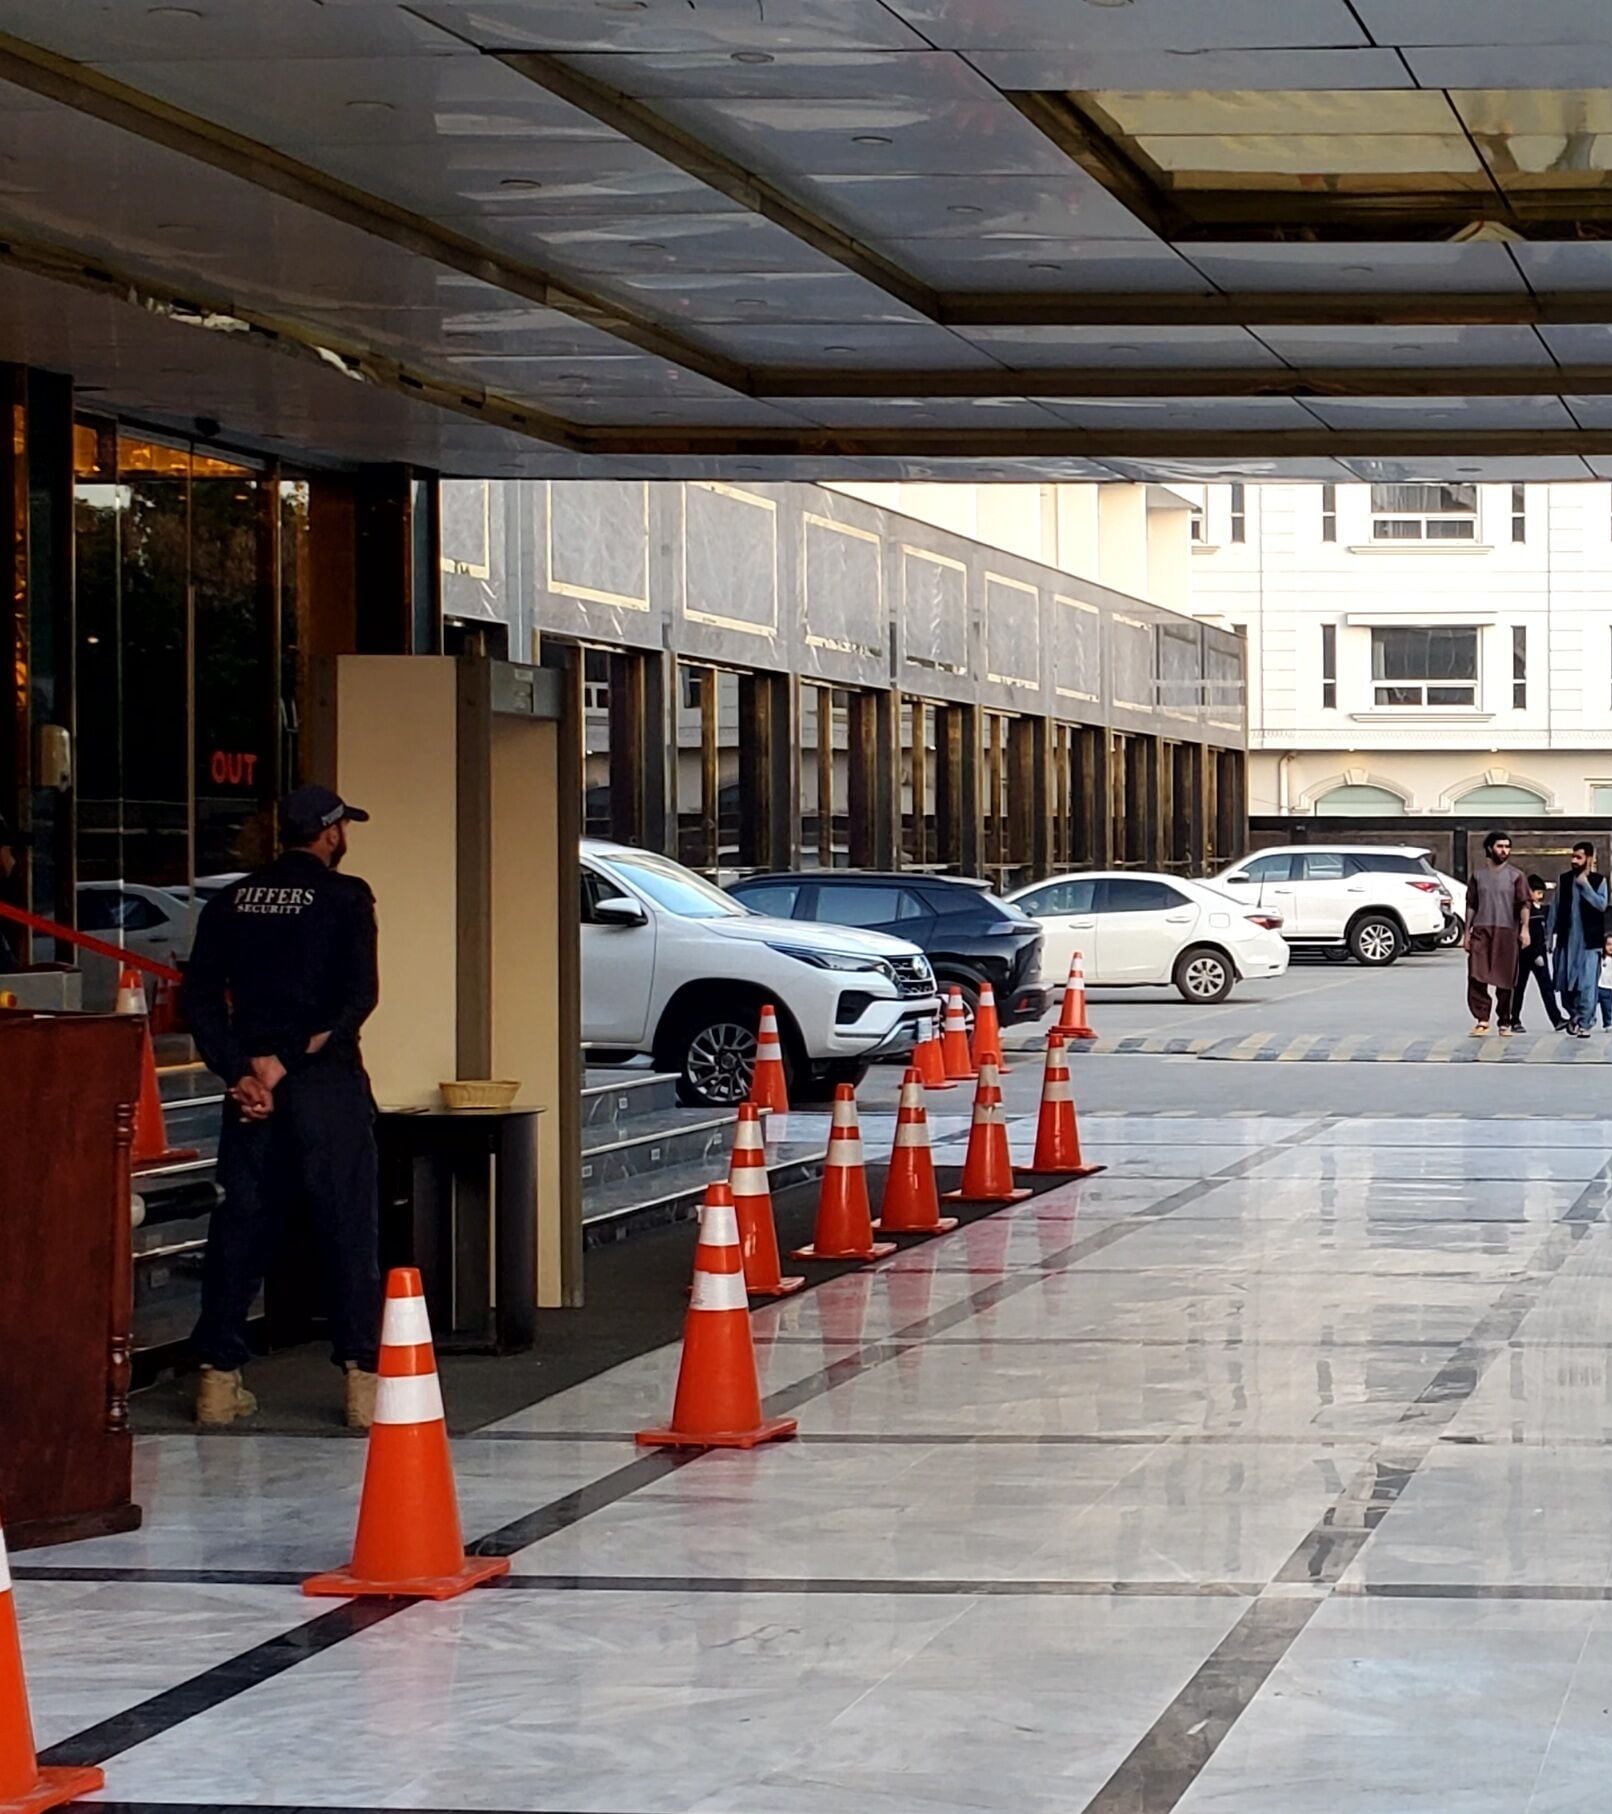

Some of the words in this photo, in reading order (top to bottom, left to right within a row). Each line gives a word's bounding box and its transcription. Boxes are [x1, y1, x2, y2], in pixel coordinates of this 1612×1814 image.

[211, 751, 257, 785] OUT
[234, 887, 316, 905] PIFFERS
[237, 904, 303, 914] SECURITY
